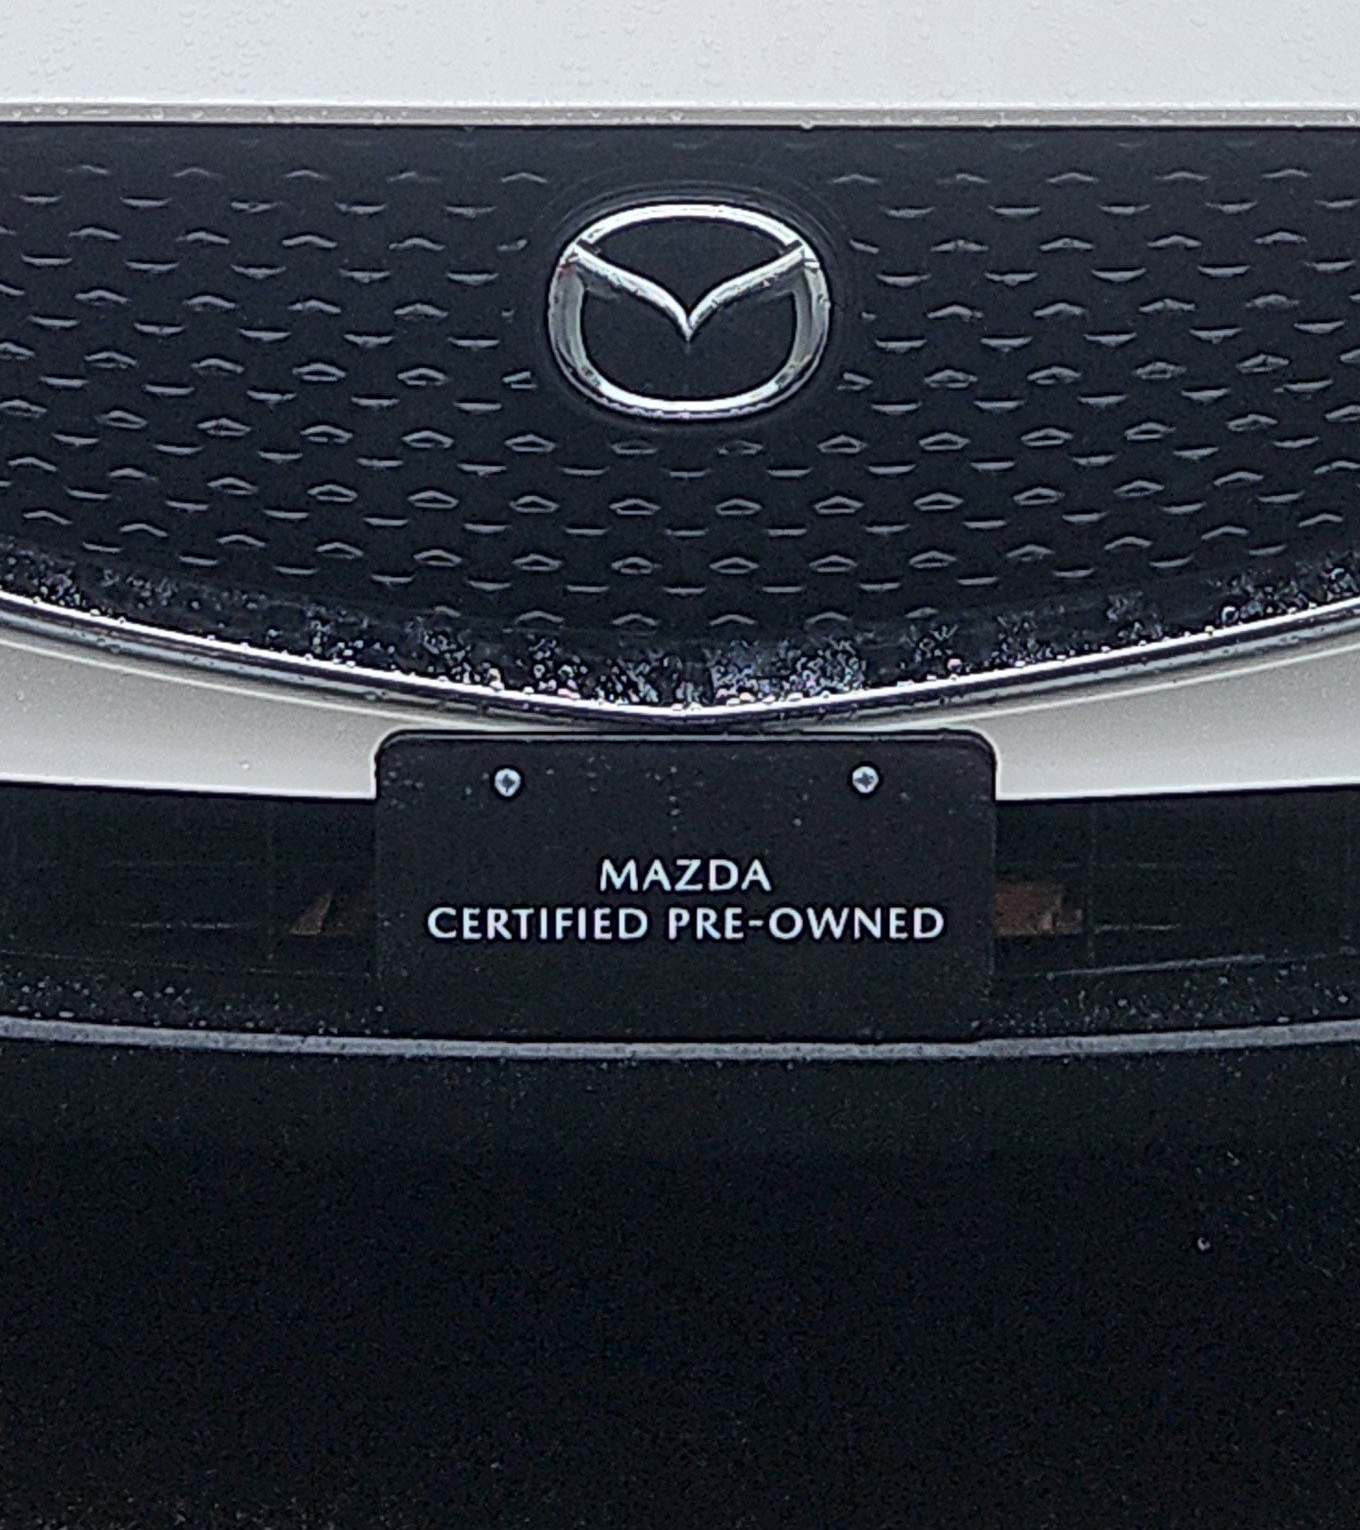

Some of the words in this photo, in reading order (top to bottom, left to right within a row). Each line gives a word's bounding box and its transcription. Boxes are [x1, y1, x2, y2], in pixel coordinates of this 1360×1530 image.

[600, 859, 772, 892] MAZDA
[427, 907, 648, 940] CERTIFIED
[668, 907, 944, 940] PRE-OWNED
